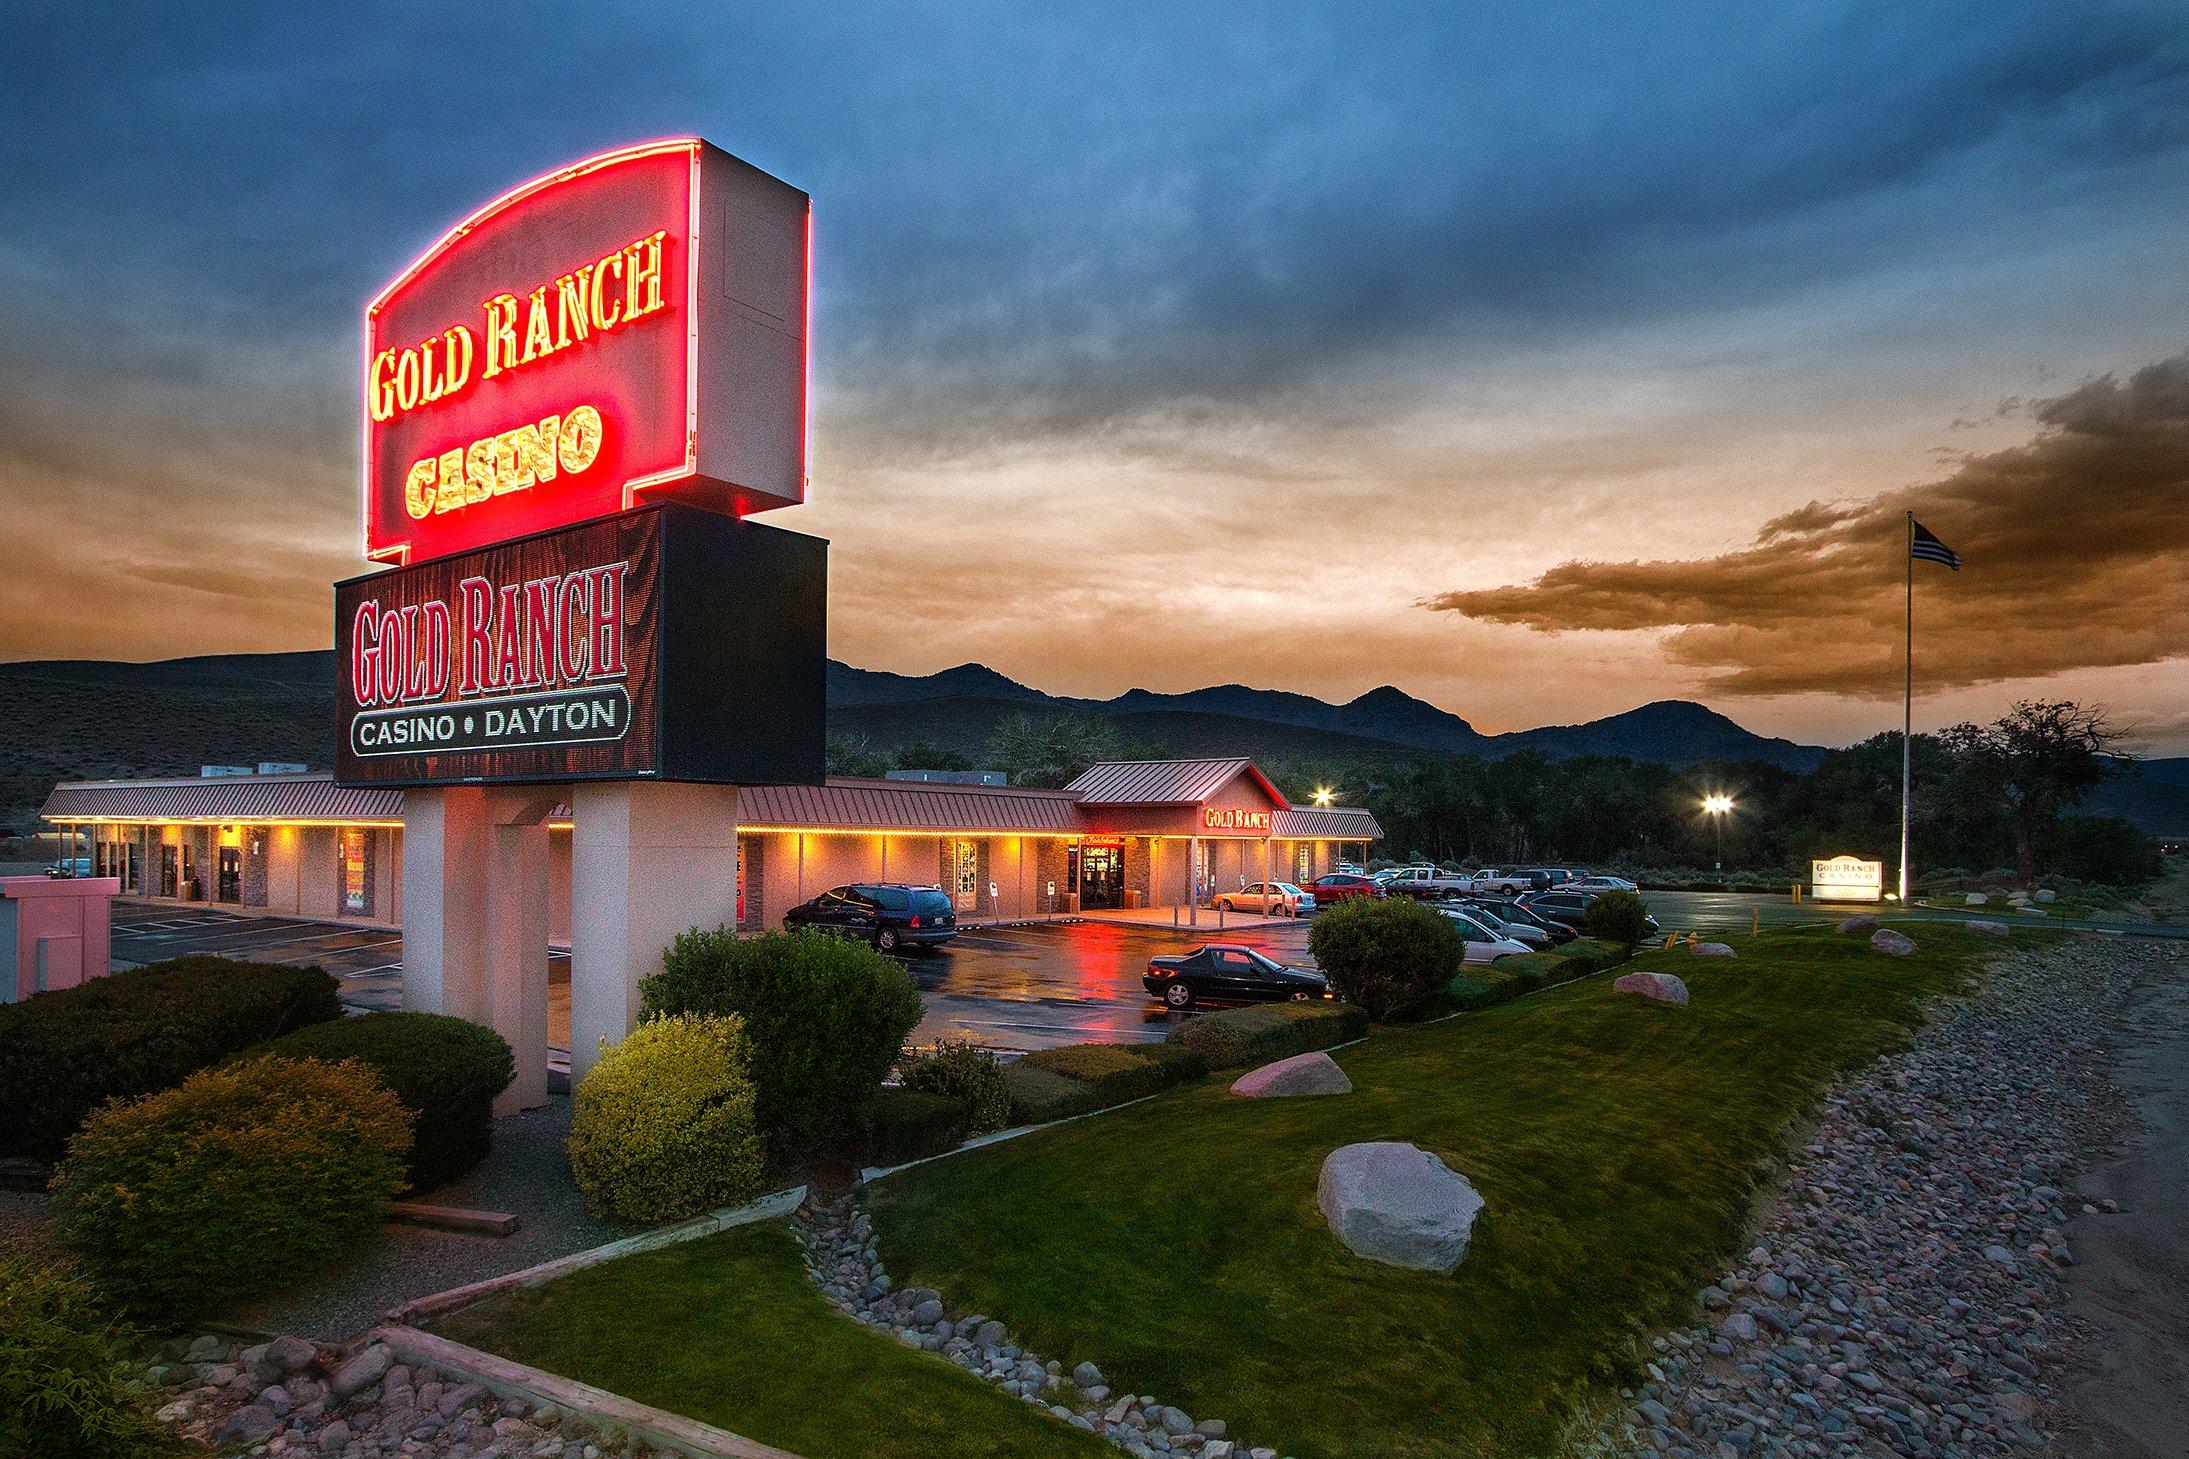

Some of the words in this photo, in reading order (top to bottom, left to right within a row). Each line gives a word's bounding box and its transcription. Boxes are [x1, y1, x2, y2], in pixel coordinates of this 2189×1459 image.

[369, 325, 473, 422] GOLD
[482, 230, 667, 379] RANCH
[404, 405, 602, 520] CASINO
[352, 598, 451, 709] GOLD
[460, 562, 629, 700] RANCH
[360, 715, 455, 748] CASINO
[485, 698, 616, 738] DAYTON
[1206, 808, 1233, 827] GOLD
[1235, 810, 1270, 829] RANCH
[1816, 863, 1841, 872] GOLD
